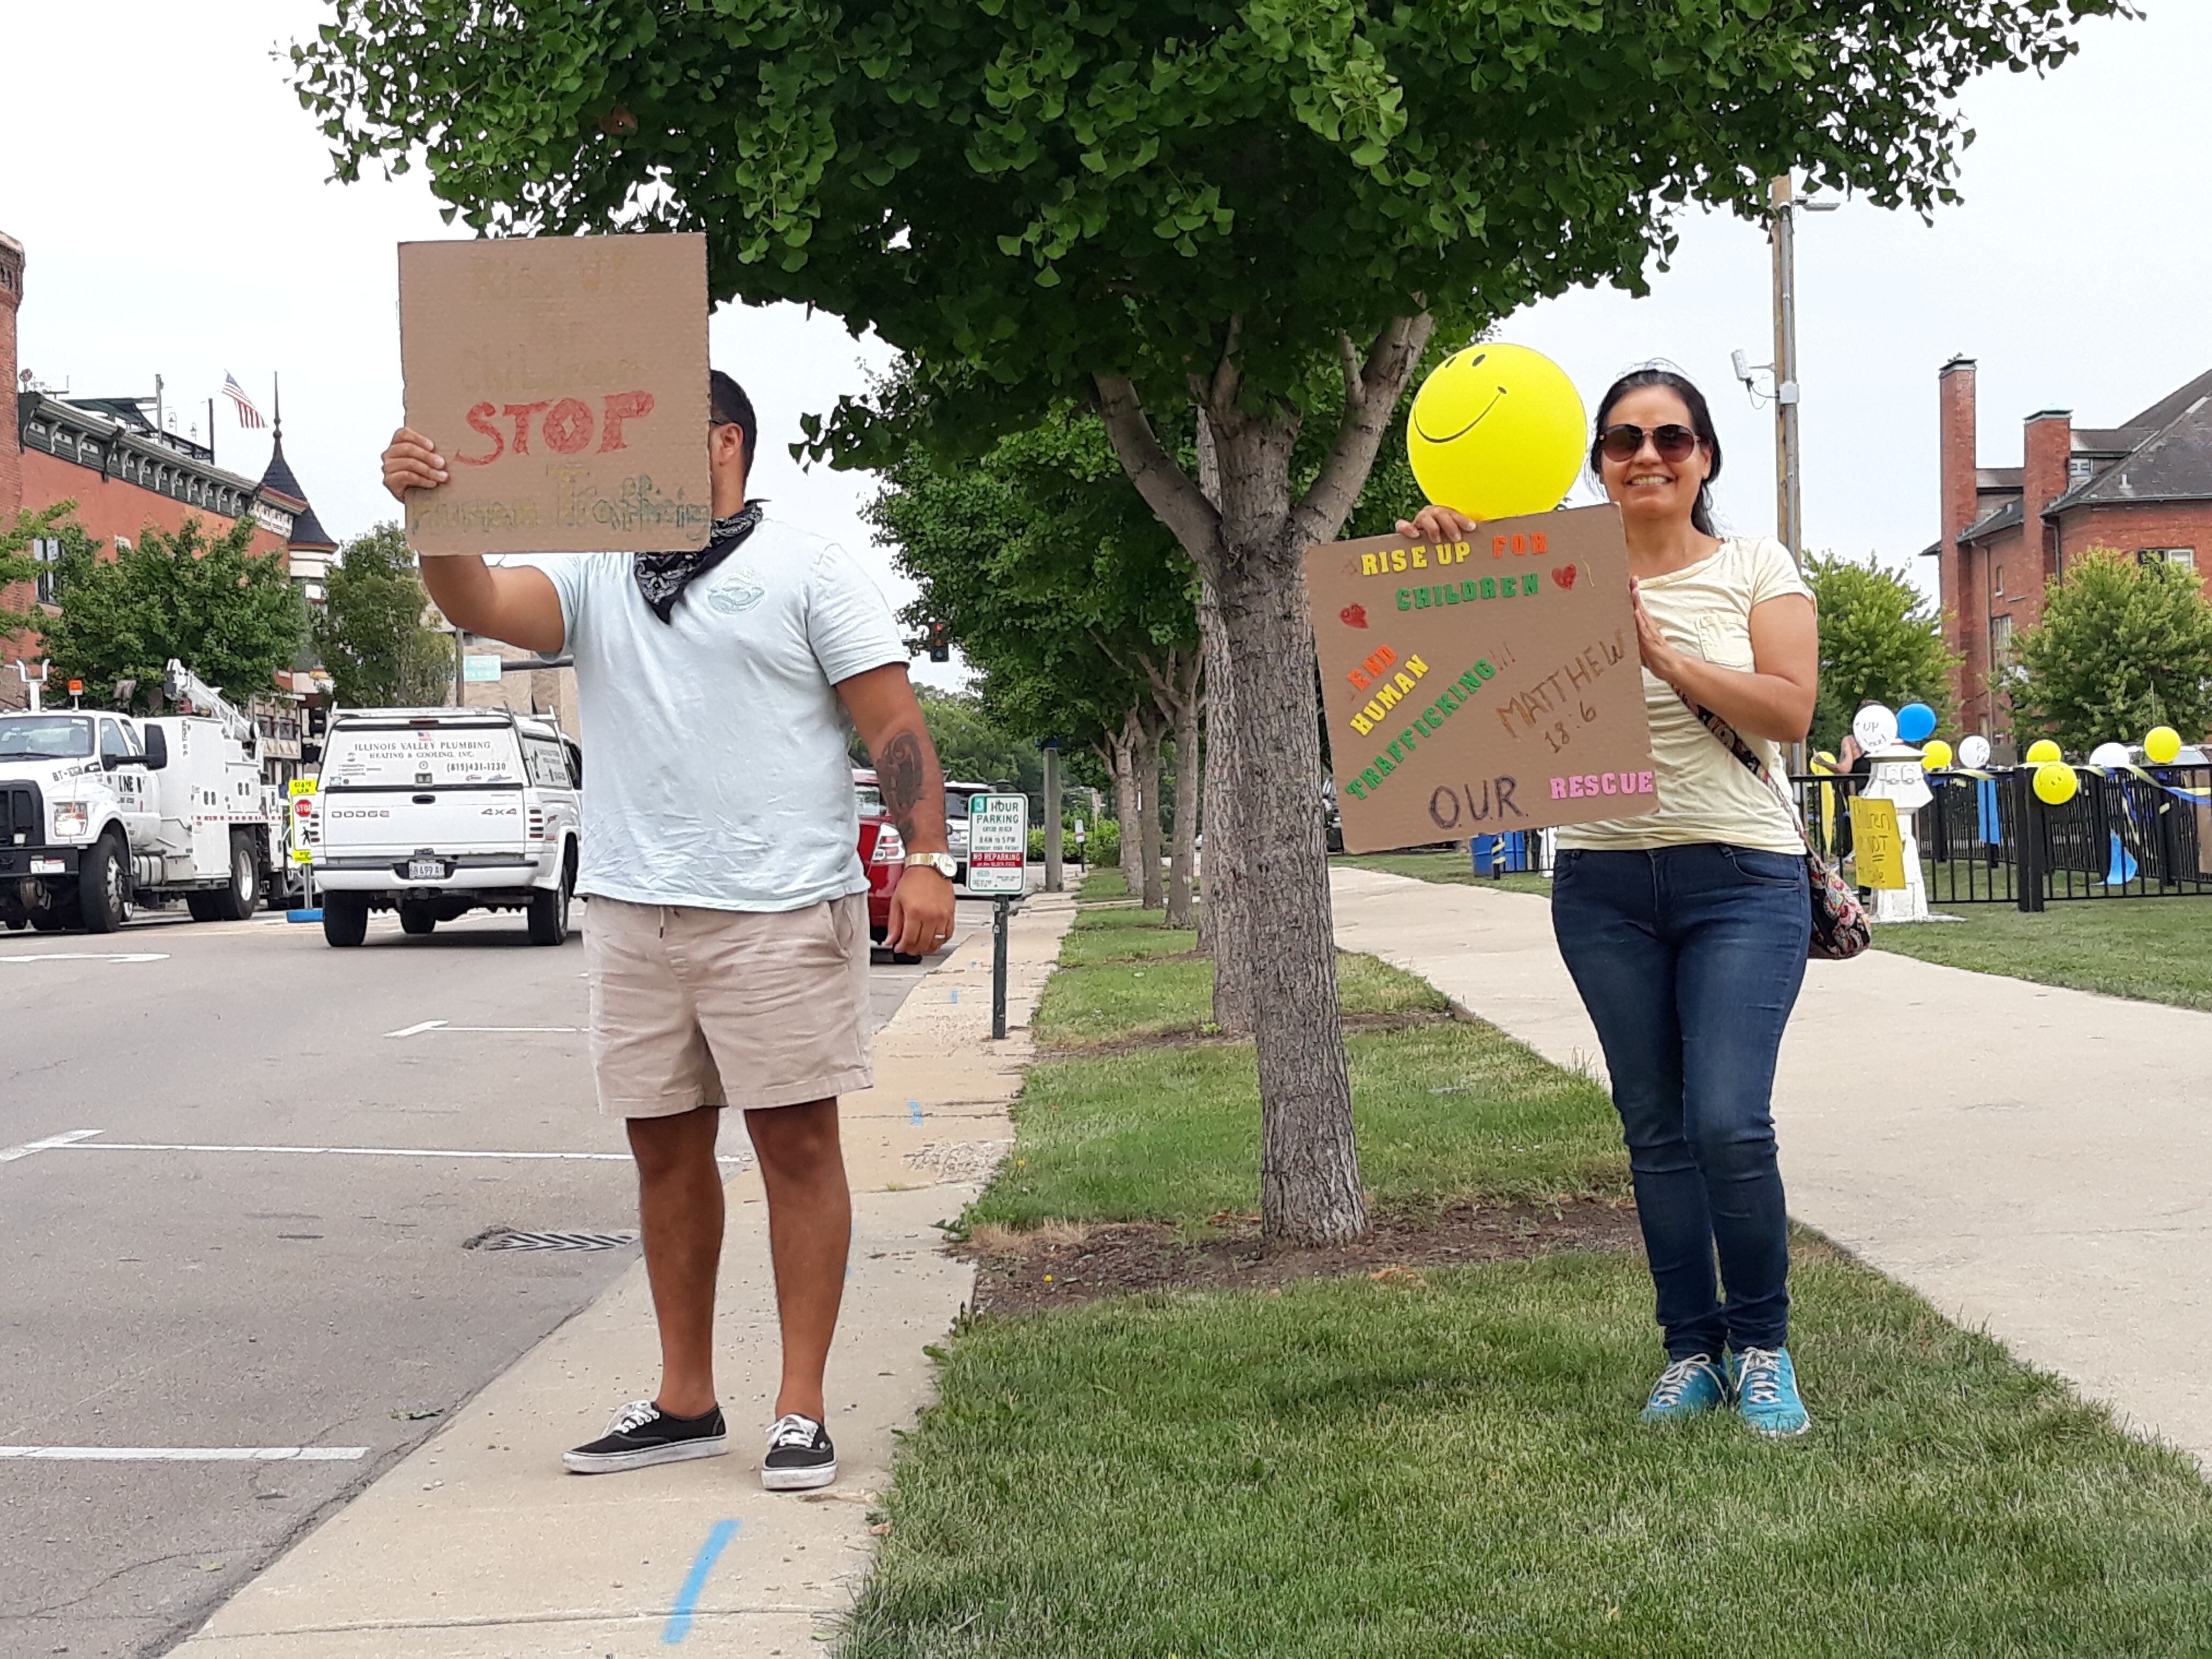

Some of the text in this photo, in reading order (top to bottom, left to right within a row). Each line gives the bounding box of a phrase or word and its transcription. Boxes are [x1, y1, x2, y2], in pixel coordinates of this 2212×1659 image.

[453, 390, 655, 466] STOP
[1361, 532, 1548, 576] RISE UP FOR
[1395, 573, 1539, 611] CHILDREN
[1347, 644, 1398, 692] END
[1496, 628, 1627, 742] MATTHEW
[1350, 654, 1430, 737] HUMAN
[355, 741, 491, 751] ILLINOIS VALLEY PLUMBING
[975, 798, 1019, 812] 3 HOUR
[1550, 771, 1654, 799] RESCUE
[976, 814, 1019, 824] PARKING
